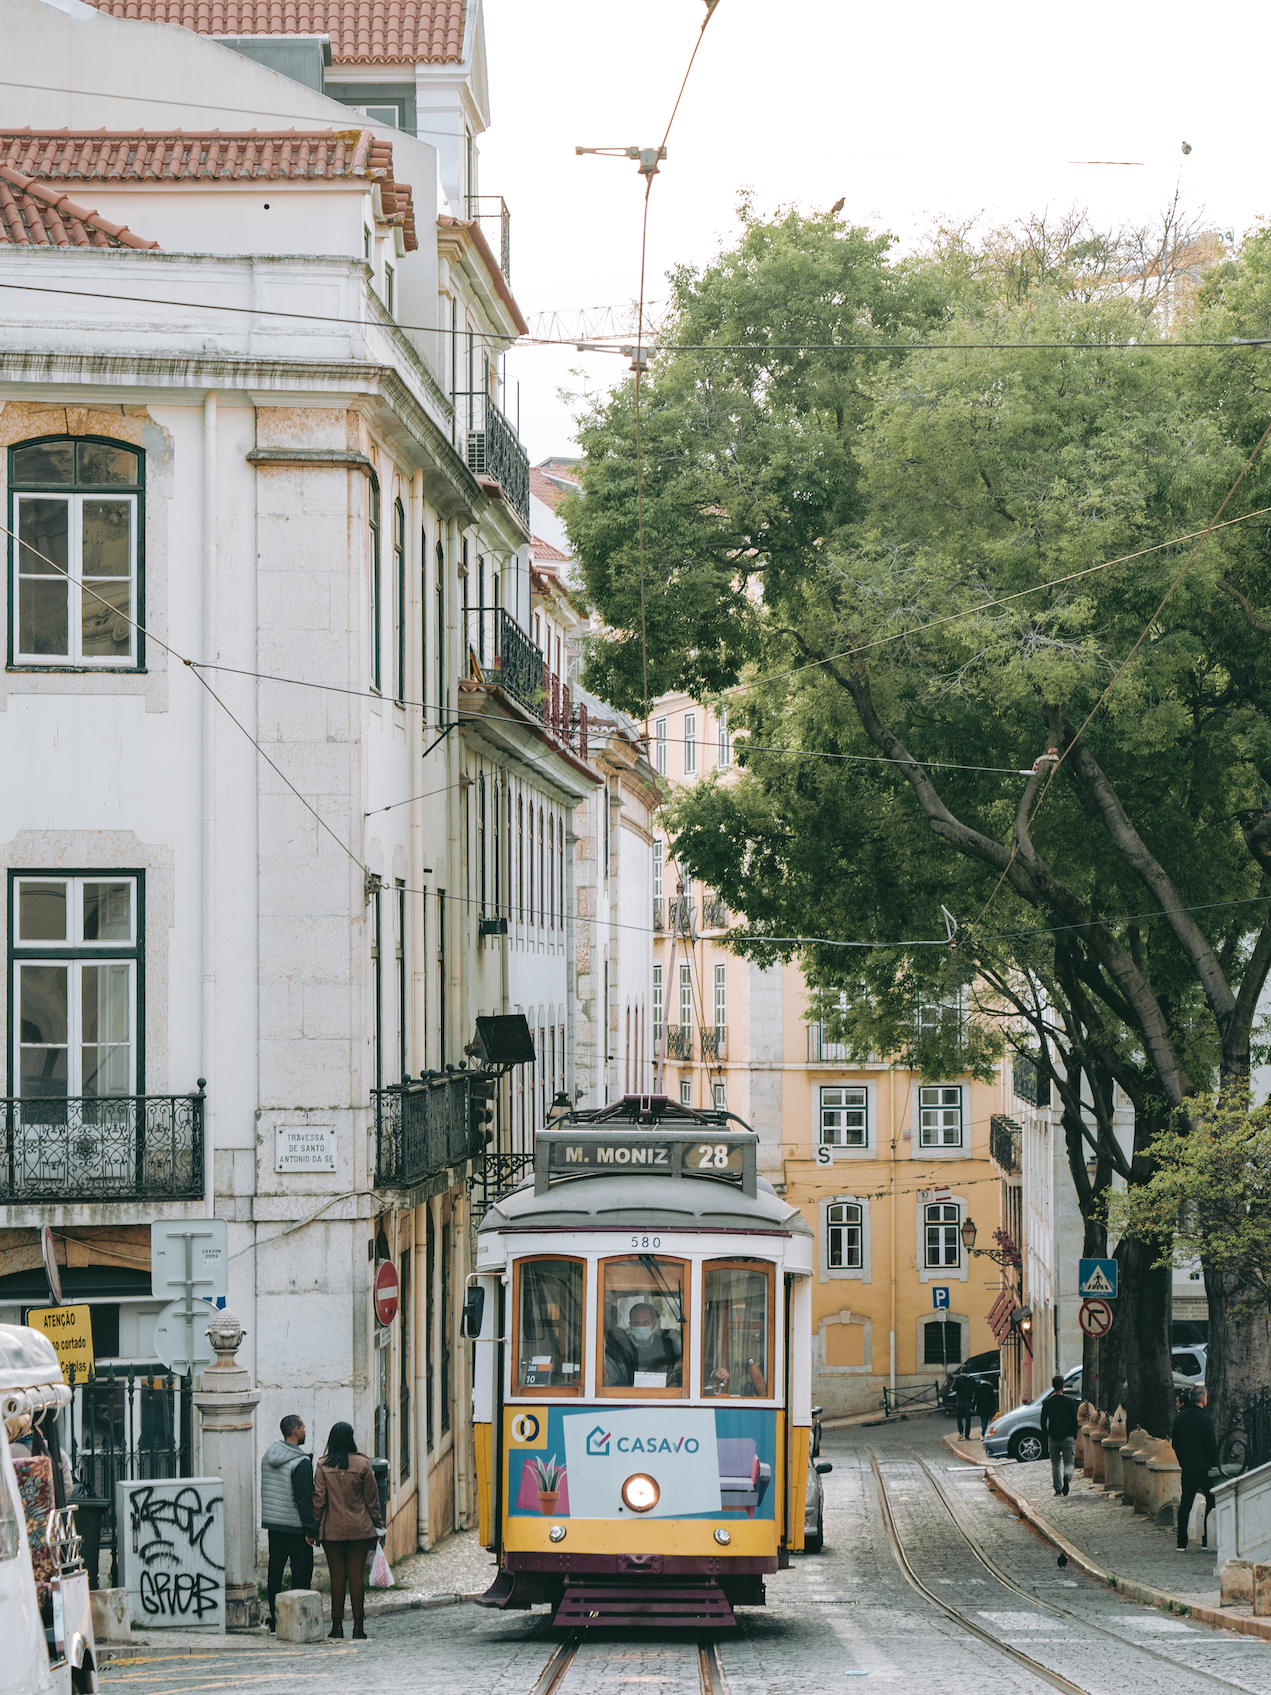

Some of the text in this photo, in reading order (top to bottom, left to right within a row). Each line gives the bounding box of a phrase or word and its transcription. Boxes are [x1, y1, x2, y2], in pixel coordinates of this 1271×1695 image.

[312, 1155, 322, 1163] DA
[565, 1144, 729, 1168] M. MONIZ 28
[818, 1146, 830, 1164] S
[631, 1236, 661, 1248] 580
[935, 1289, 946, 1306] P
[44, 1310, 75, 1329] ATENÇÃO
[61, 1336, 86, 1350] cortado
[526, 1375, 536, 1384] 10
[616, 1436, 700, 1454] CASAVO
